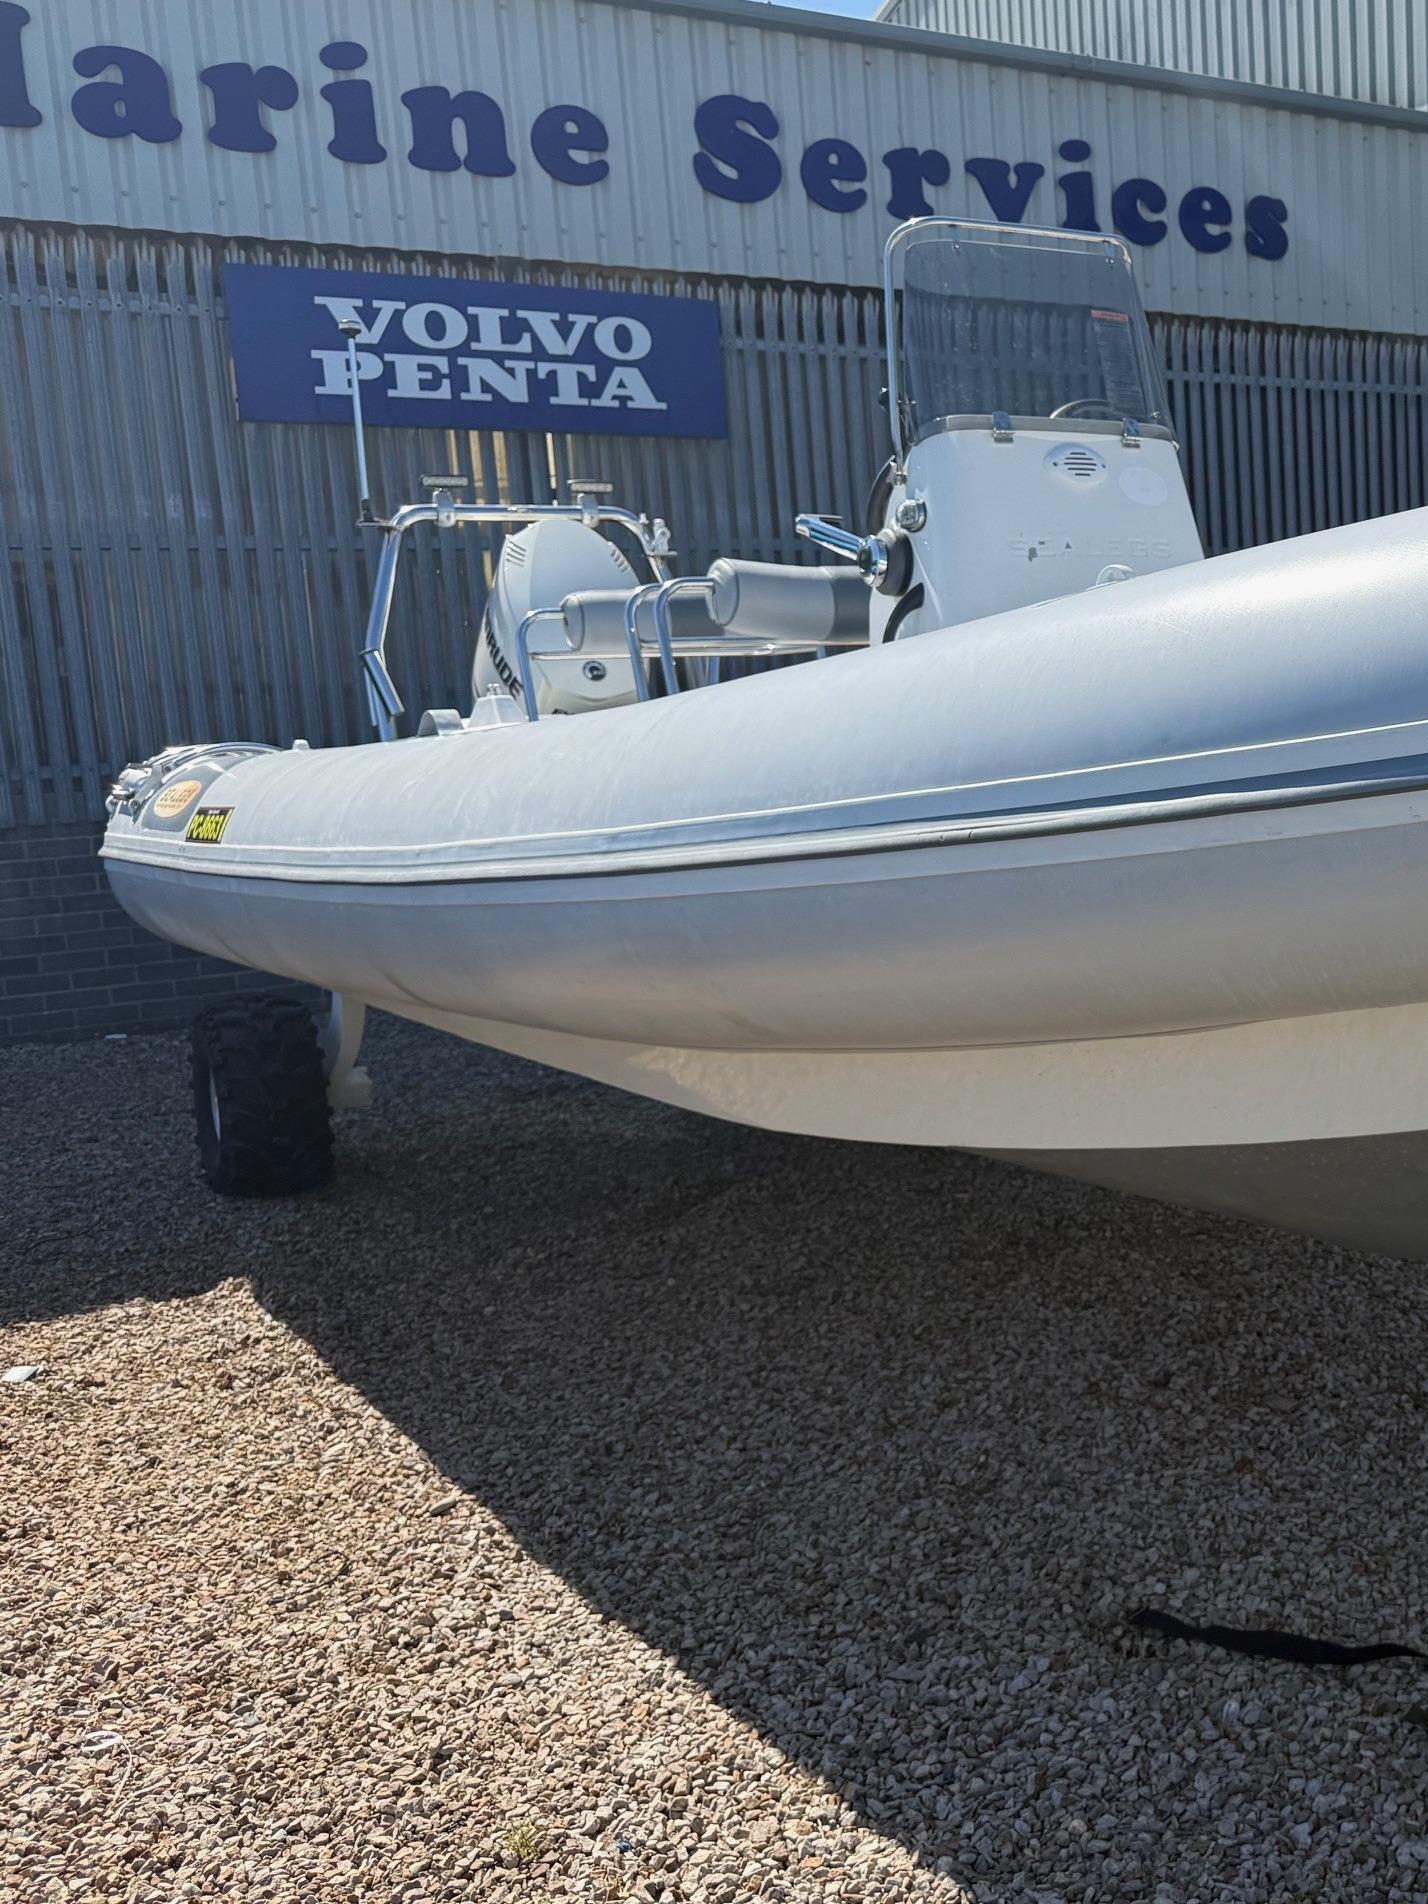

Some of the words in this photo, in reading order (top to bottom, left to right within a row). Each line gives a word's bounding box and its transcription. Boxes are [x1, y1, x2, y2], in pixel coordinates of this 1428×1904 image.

[692, 95, 1289, 261] Services
[314, 296, 652, 361] VOLVO
[311, 350, 667, 410] PENTA
